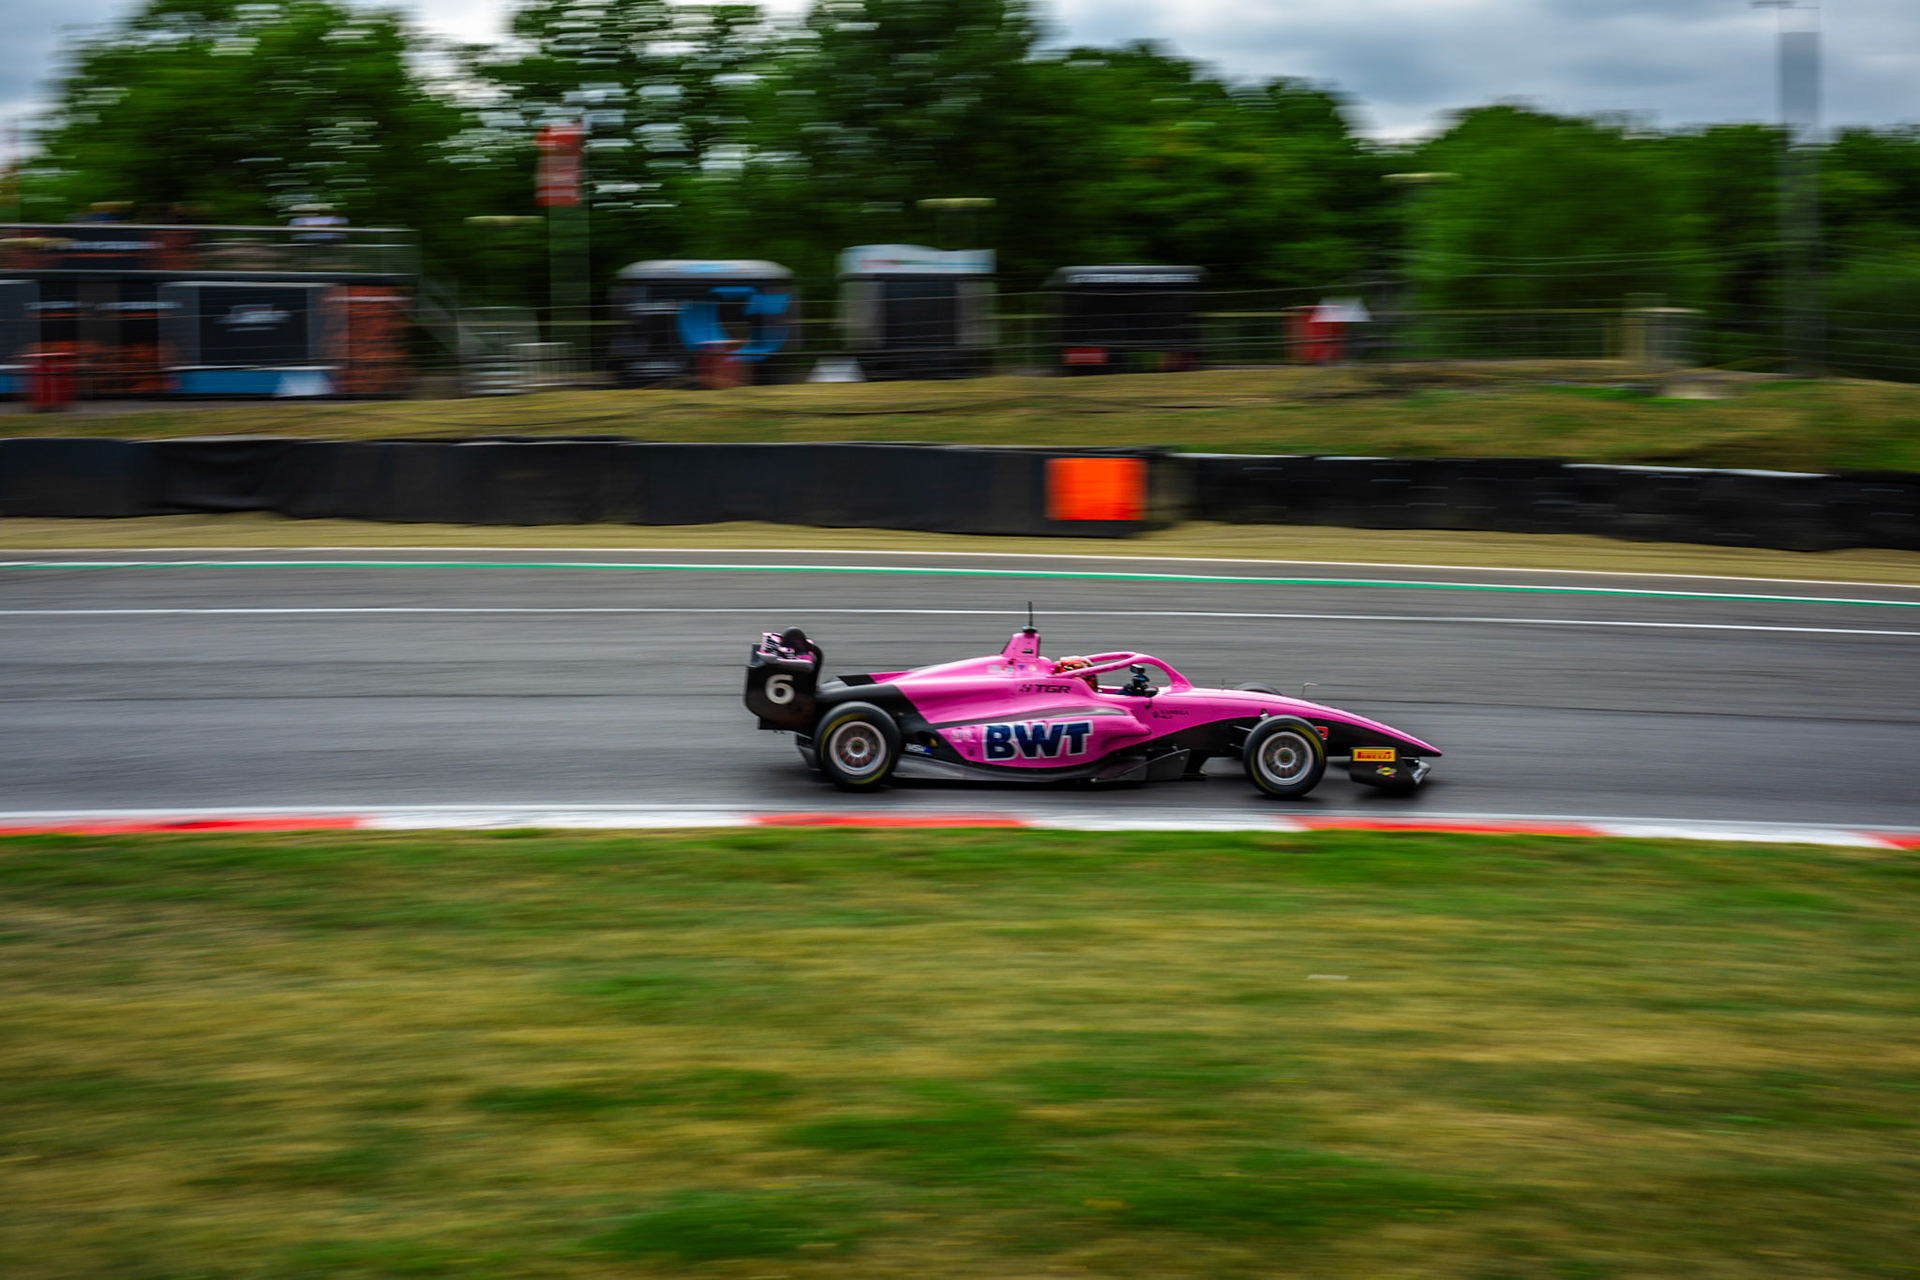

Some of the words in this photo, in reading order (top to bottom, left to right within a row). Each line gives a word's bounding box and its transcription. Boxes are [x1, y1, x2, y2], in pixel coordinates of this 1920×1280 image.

[765, 674, 795, 704] 6
[1034, 684, 1071, 694] TGR
[983, 720, 1093, 761] BWT
[1357, 751, 1392, 759] PIRELLI
